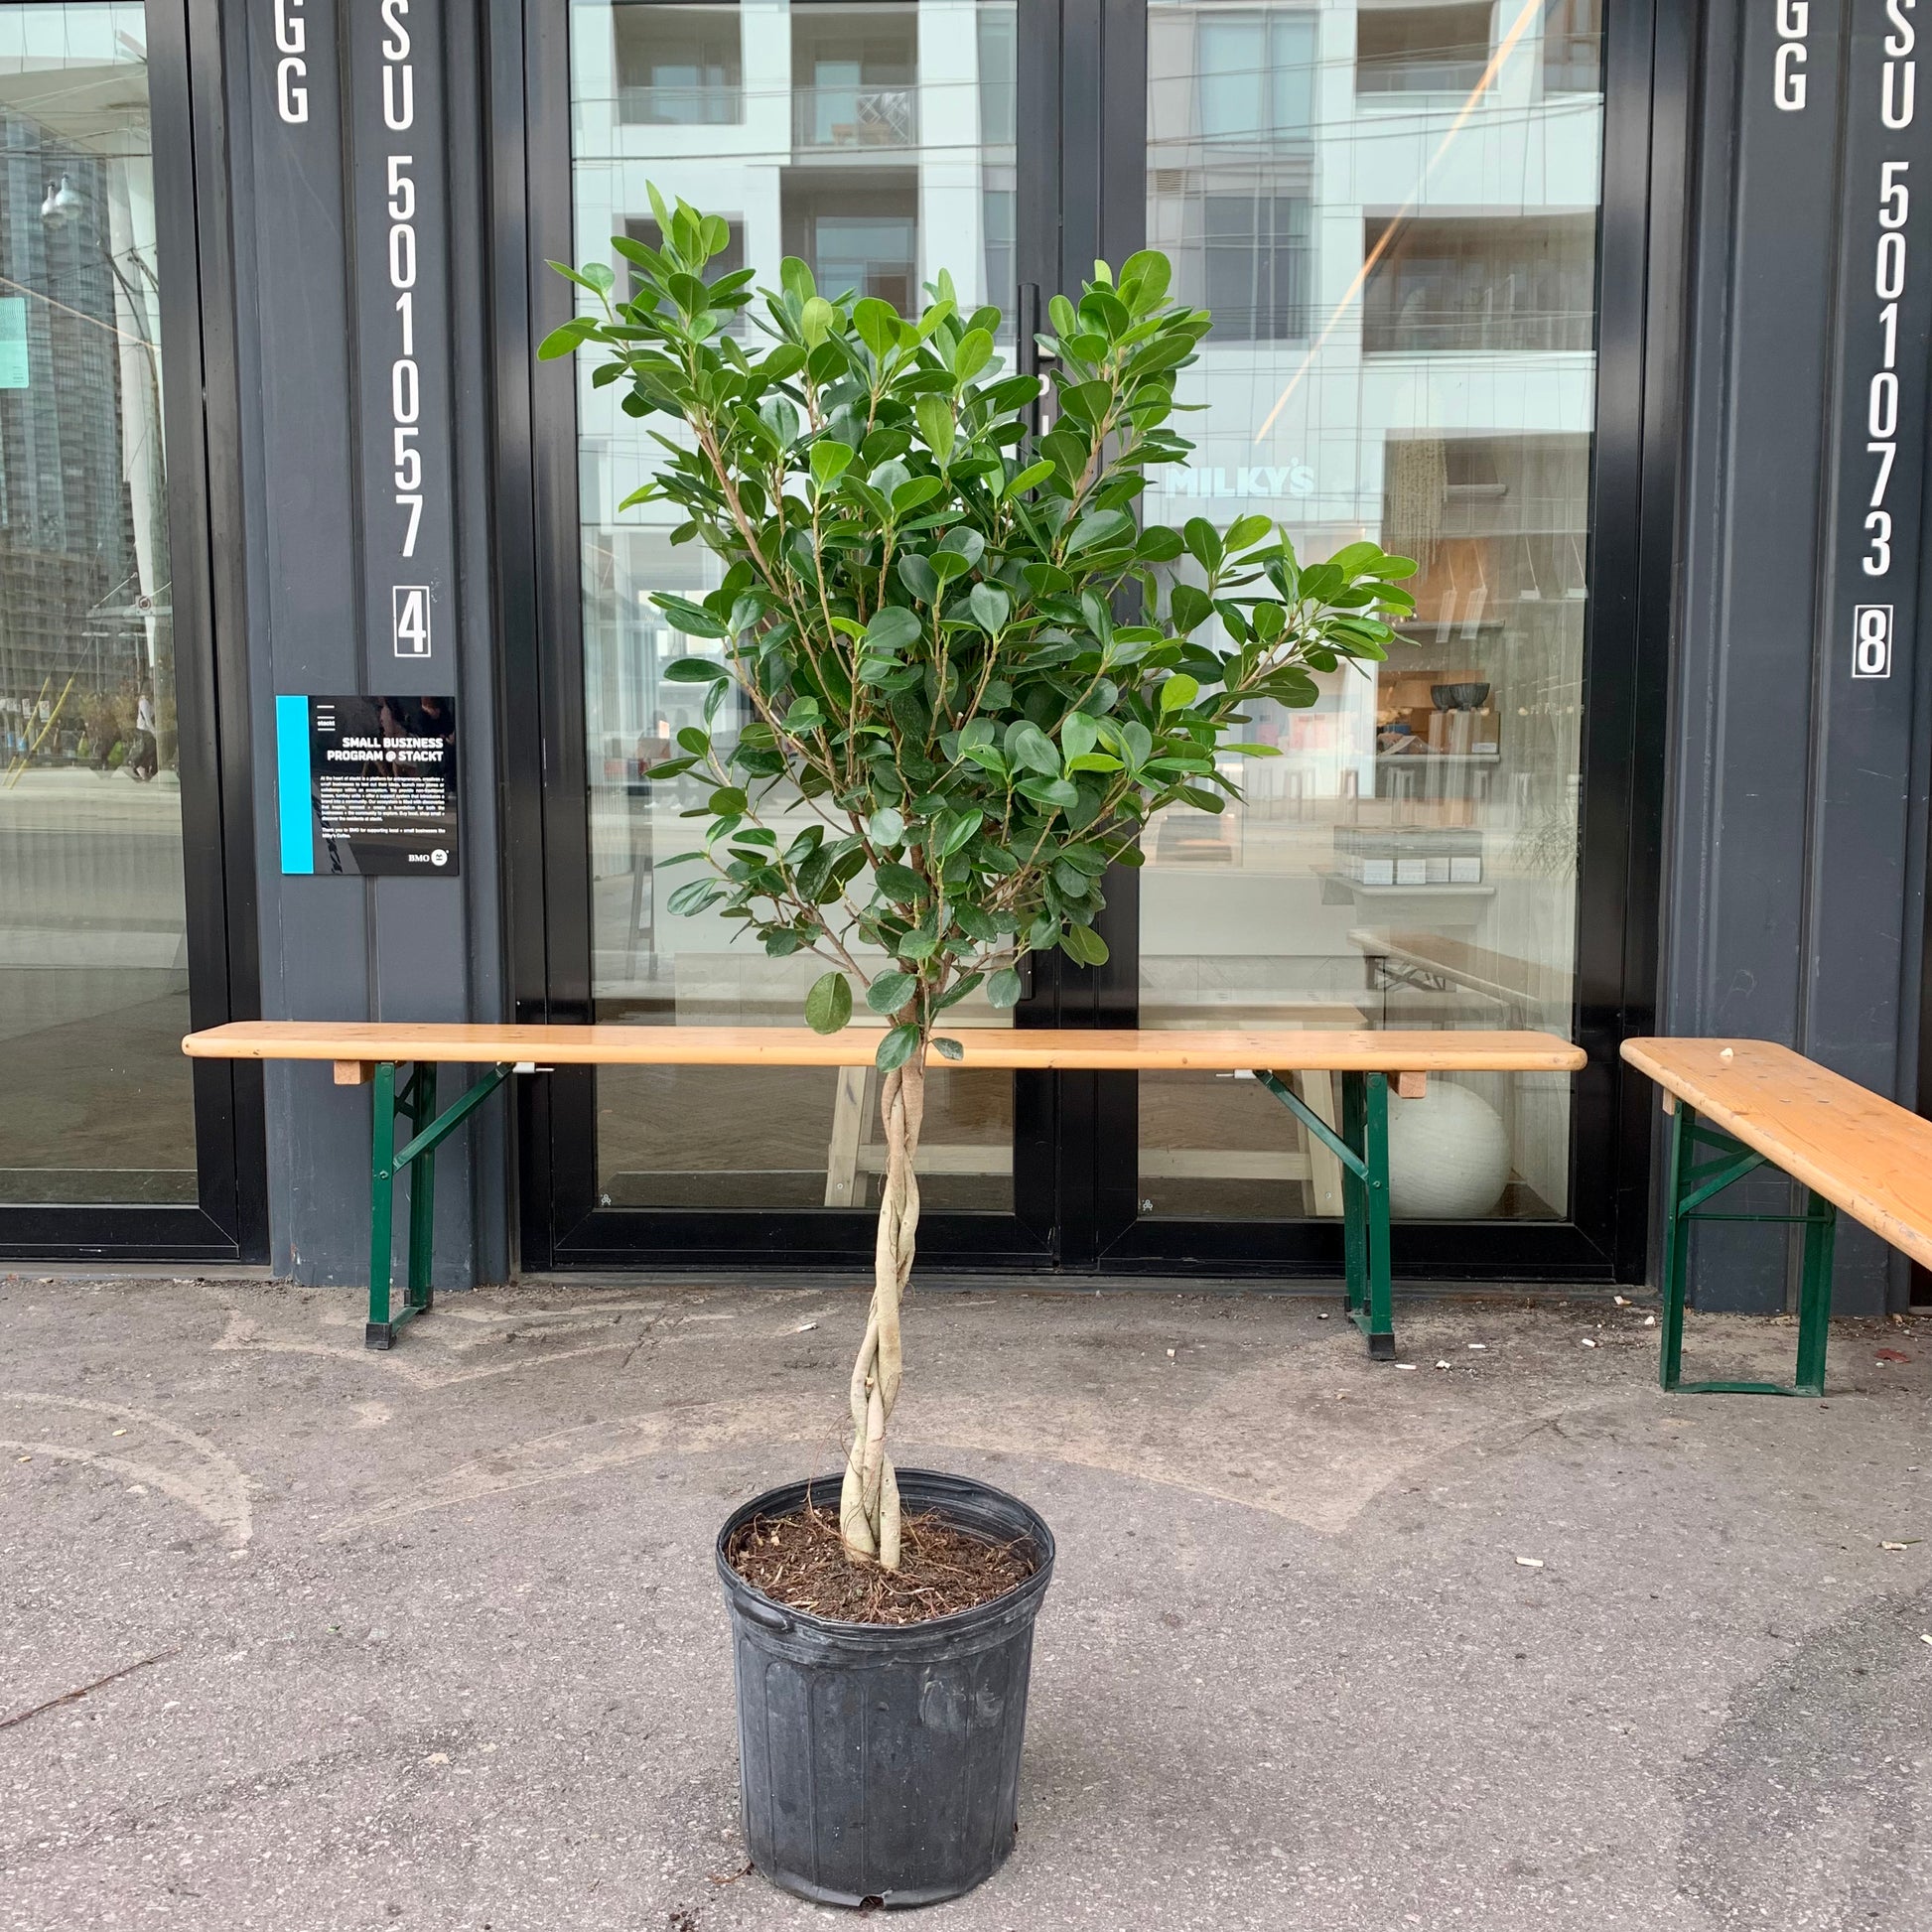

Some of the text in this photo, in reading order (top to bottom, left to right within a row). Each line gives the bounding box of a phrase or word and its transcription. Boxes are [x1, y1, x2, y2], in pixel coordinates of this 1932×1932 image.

[388, 156, 423, 557] 501057
[1863, 162, 1908, 575] 501073
[1166, 457, 1315, 498] MILKY'S
[396, 589, 428, 654] 4
[1858, 609, 1887, 674] 8
[327, 750, 444, 762] PROGRAM @ STACKT
[342, 737, 444, 749] SMALL BUSINESS
